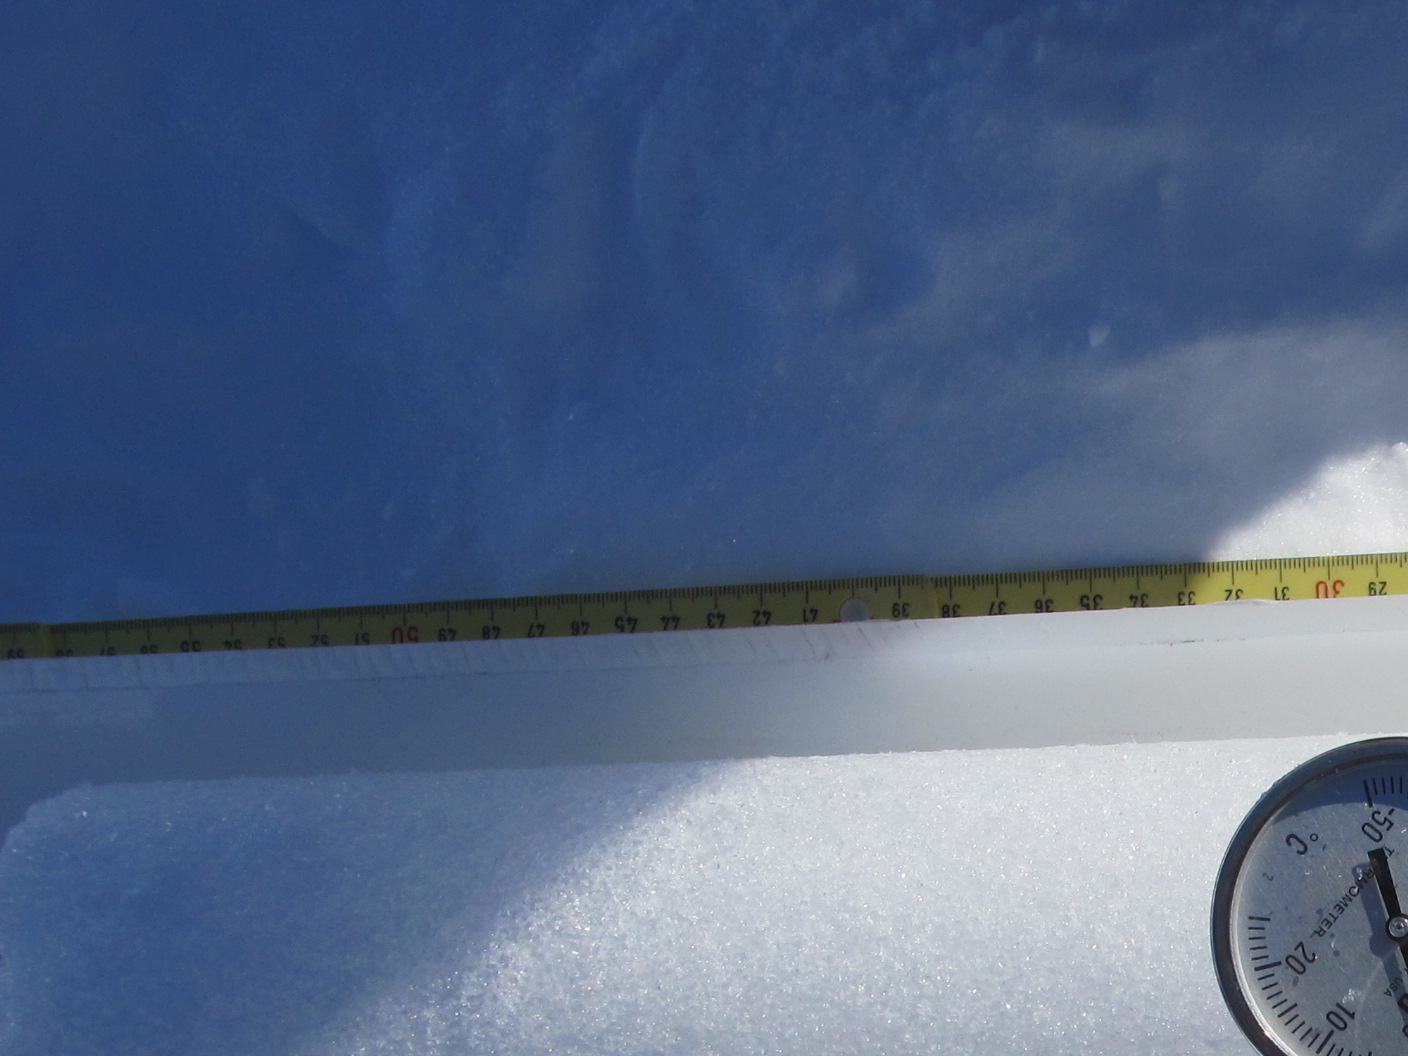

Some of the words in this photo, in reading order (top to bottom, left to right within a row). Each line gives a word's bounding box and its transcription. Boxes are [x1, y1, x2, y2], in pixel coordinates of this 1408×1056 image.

[1274, 587, 1290, 600] 31
[1315, 580, 1345, 599] 30
[1368, 582, 1387, 596] 29
[1035, 599, 1053, 613] 36
[1080, 594, 1103, 610] 35
[1129, 593, 1149, 608] 34
[1177, 591, 1196, 606] 33
[803, 608, 818, 623] 41
[892, 603, 910, 618] 39
[942, 604, 961, 618] 38
[988, 601, 1006, 615] 37
[615, 616, 638, 633] 45
[662, 615, 680, 631] 44
[707, 613, 726, 628] 43
[753, 610, 772, 626] 42
[438, 628, 457, 642] 49
[482, 625, 501, 640] 48
[527, 623, 545, 638] 47
[571, 620, 590, 636] 46
[1361, 808, 1395, 843] -50
[1314, 847, 1395, 938] TRMOMETER
[1285, 941, 1317, 975] 20
[1384, 975, 1406, 998] USA
[1326, 1002, 1356, 1032] 10
